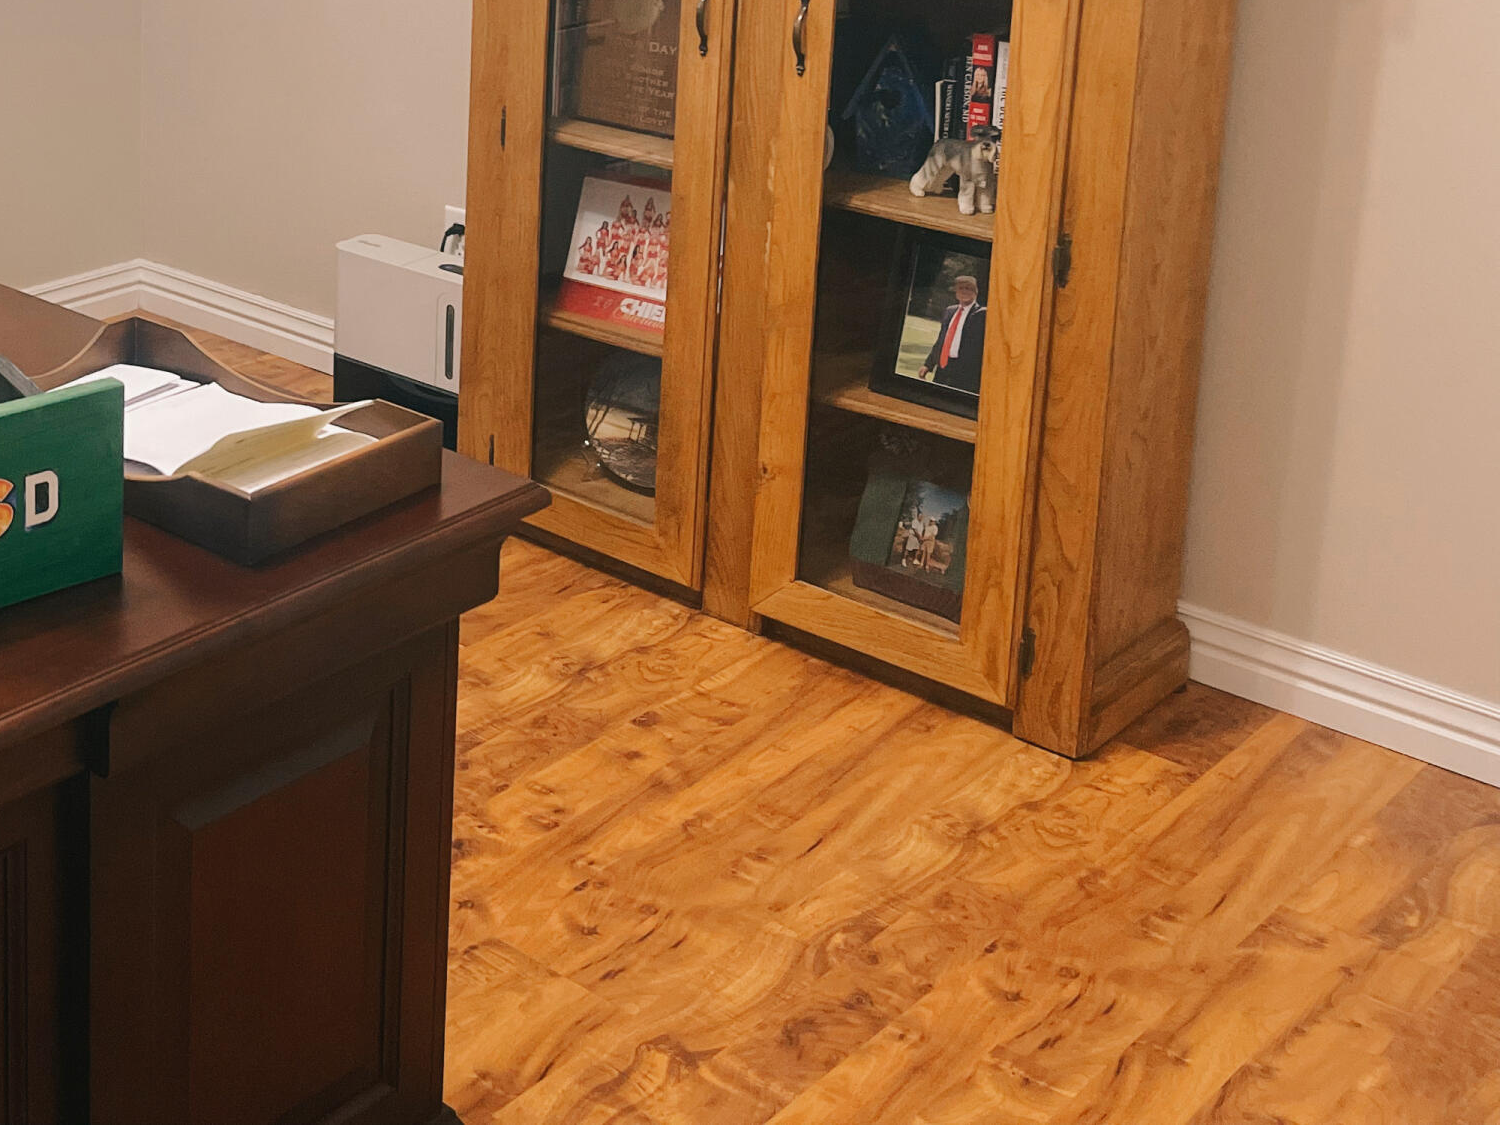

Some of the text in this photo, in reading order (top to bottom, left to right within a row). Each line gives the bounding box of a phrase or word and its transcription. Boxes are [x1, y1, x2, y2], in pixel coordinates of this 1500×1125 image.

[965, 56, 974, 72] BEN
[962, 109, 970, 123] MD
[620, 297, 665, 322] CHIE
